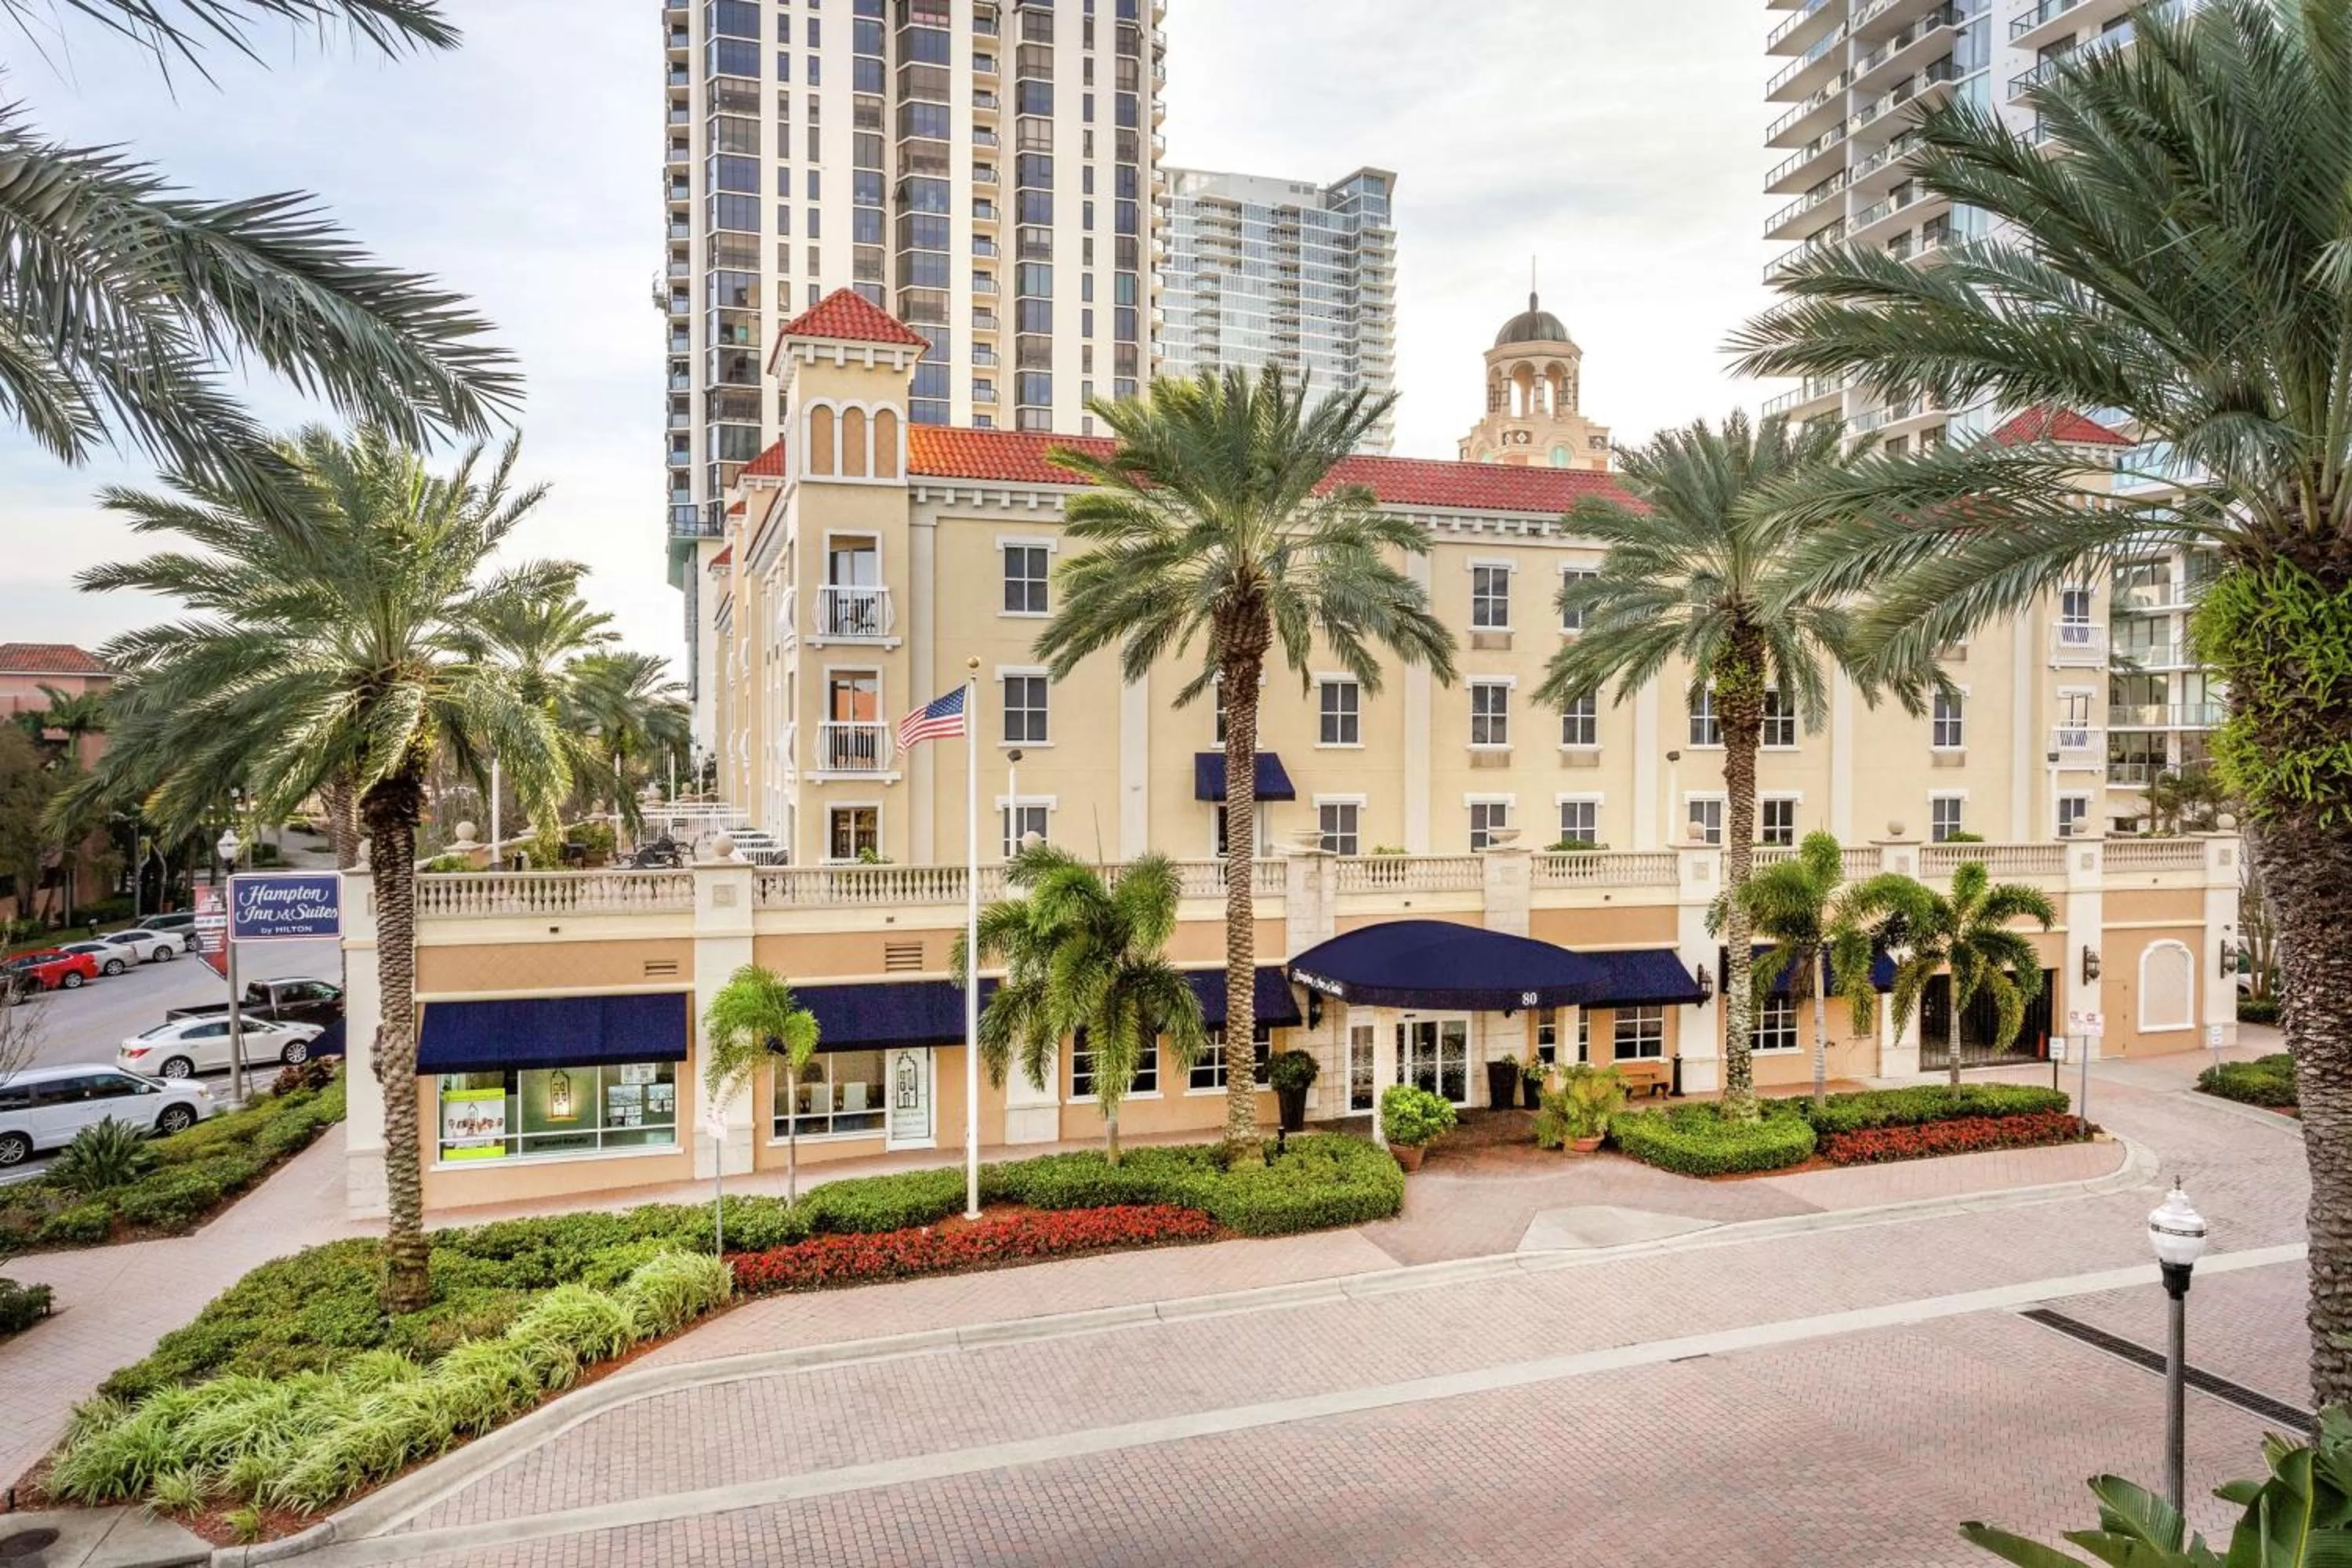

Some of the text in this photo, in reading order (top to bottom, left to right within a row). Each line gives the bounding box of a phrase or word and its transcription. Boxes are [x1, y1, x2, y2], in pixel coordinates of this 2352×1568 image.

[239, 884, 328, 906] Hampton
[236, 906, 280, 923] Inn
[281, 908, 292, 920] &
[291, 903, 338, 920] Suites
[1522, 992, 1537, 1006] 80
